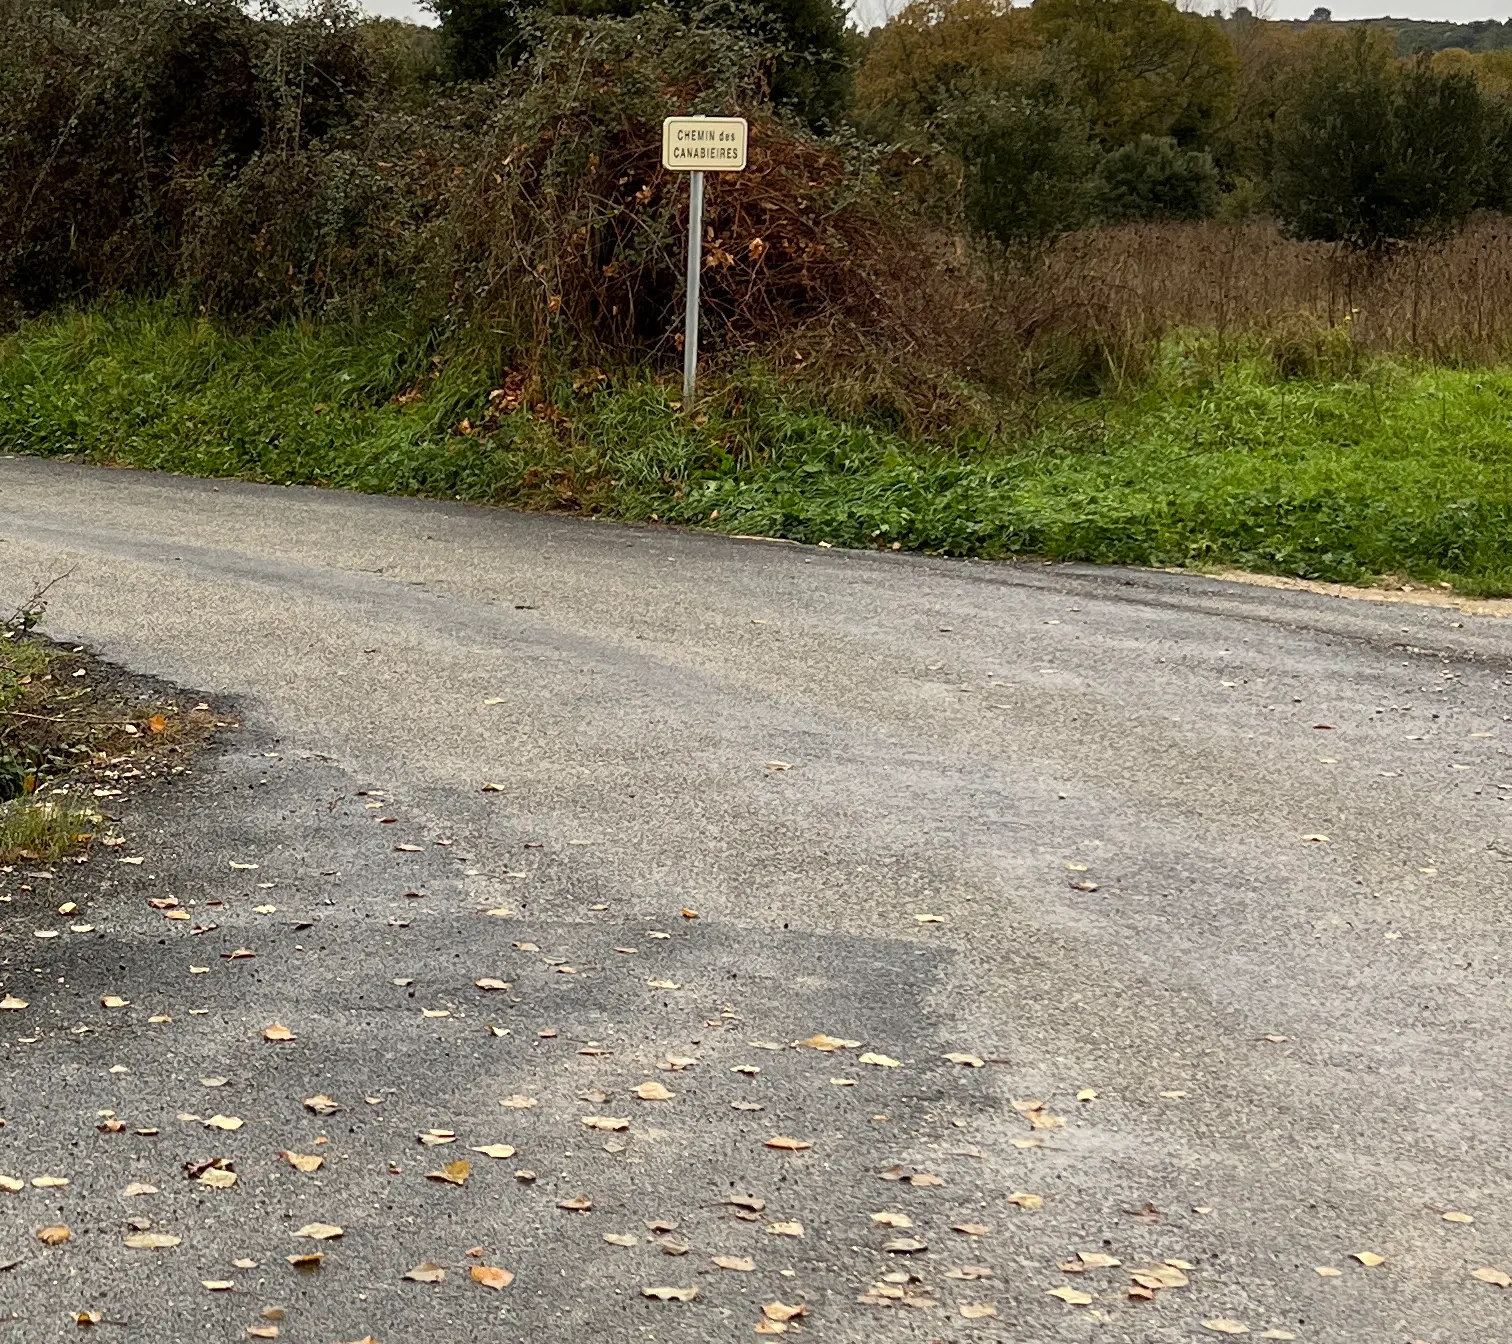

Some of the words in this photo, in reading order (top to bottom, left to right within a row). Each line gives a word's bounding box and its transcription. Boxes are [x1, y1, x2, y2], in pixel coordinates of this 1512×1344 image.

[677, 129, 715, 142] CHEMIN
[719, 131, 736, 142] des
[673, 146, 738, 159] CANABIEIRES
